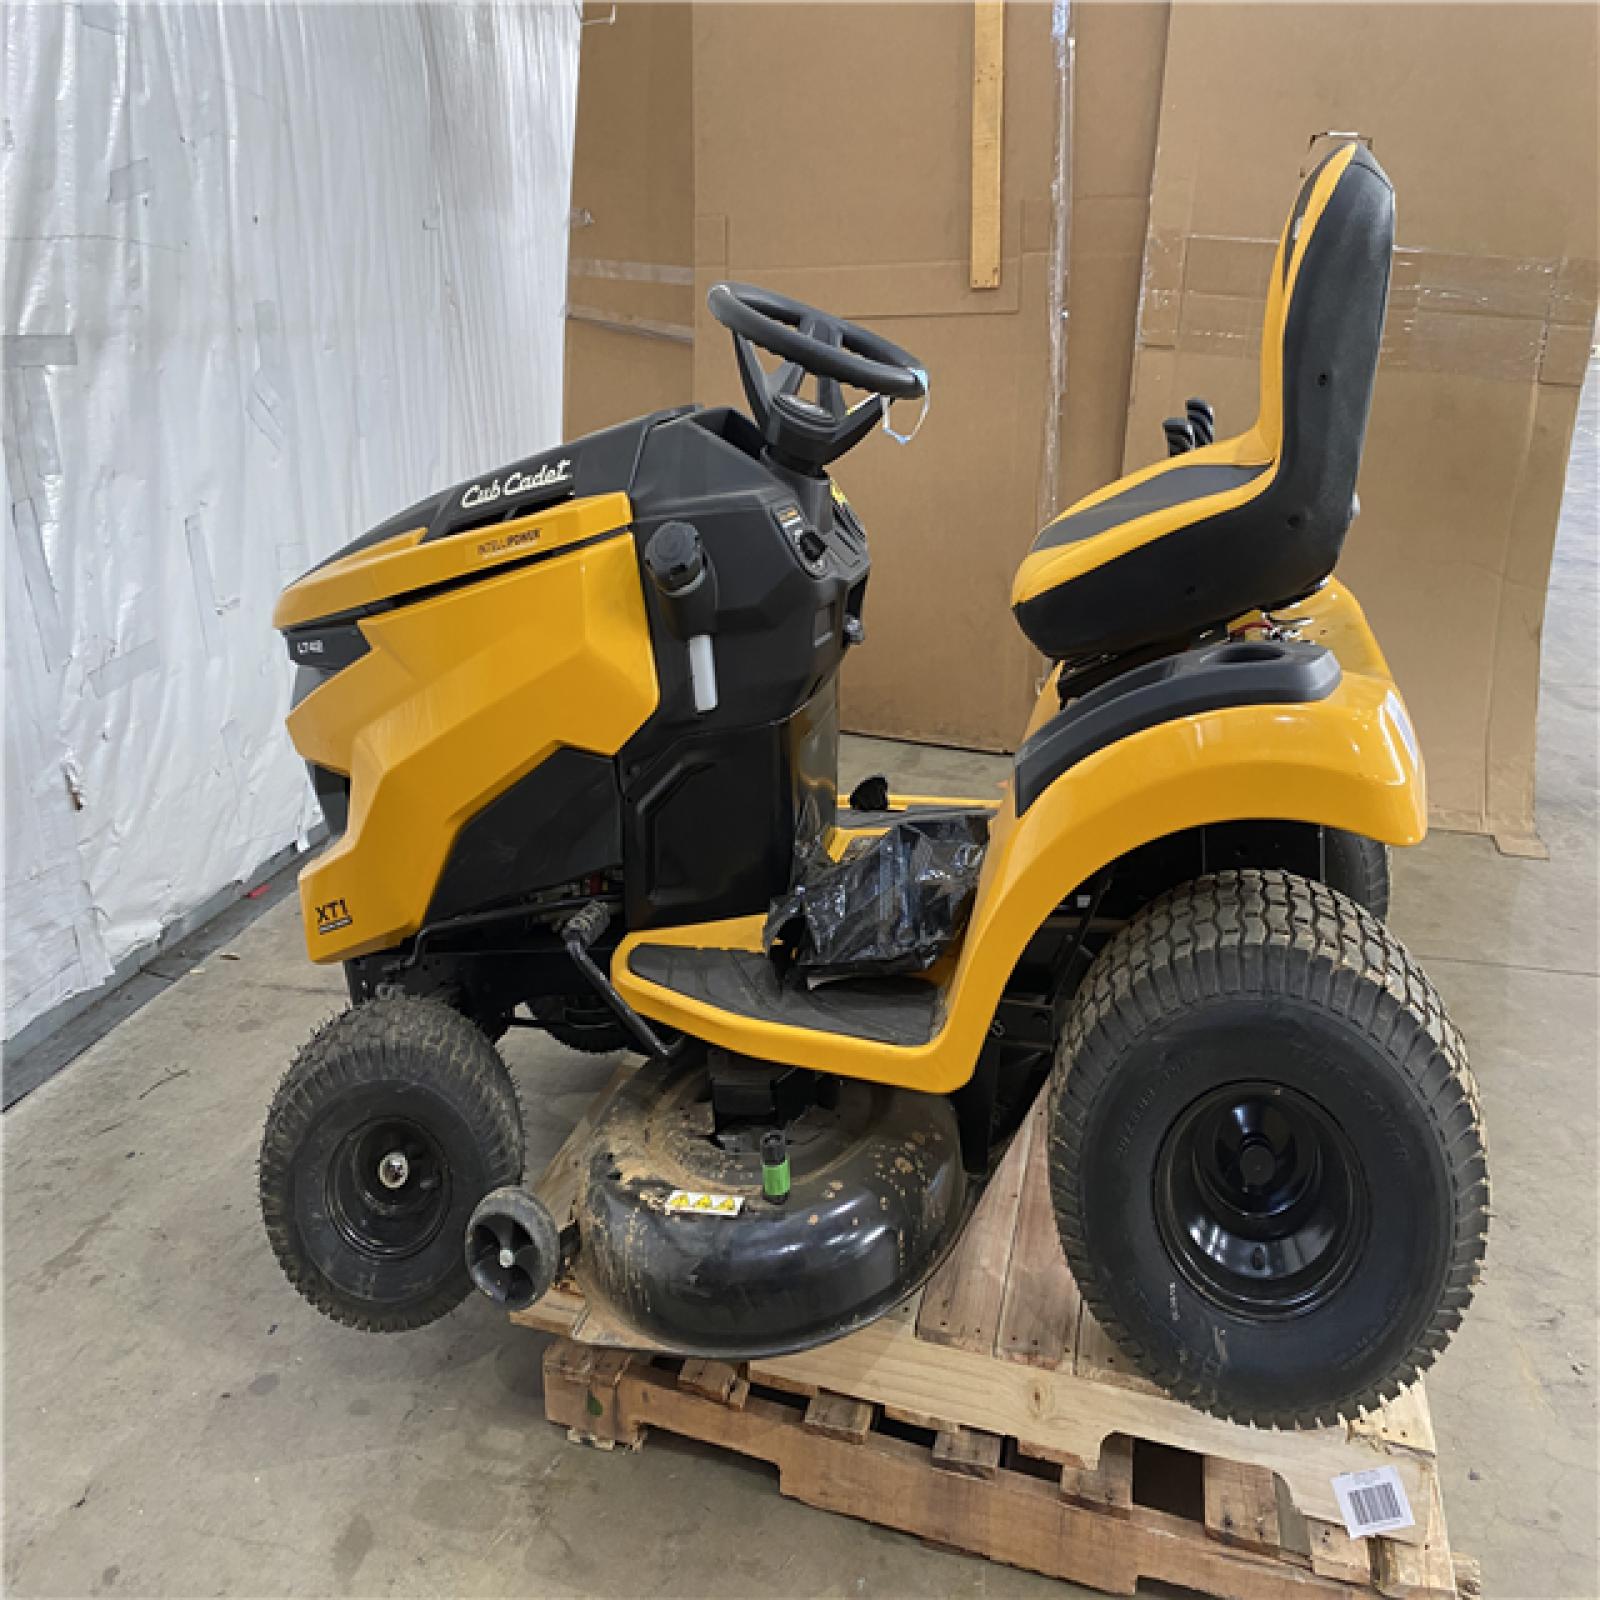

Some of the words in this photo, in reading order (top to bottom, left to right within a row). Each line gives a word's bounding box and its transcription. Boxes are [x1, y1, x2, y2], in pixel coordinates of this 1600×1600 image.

[460, 479, 501, 508] Cub
[503, 459, 572, 495] Cadet
[315, 898, 348, 922] XT1
